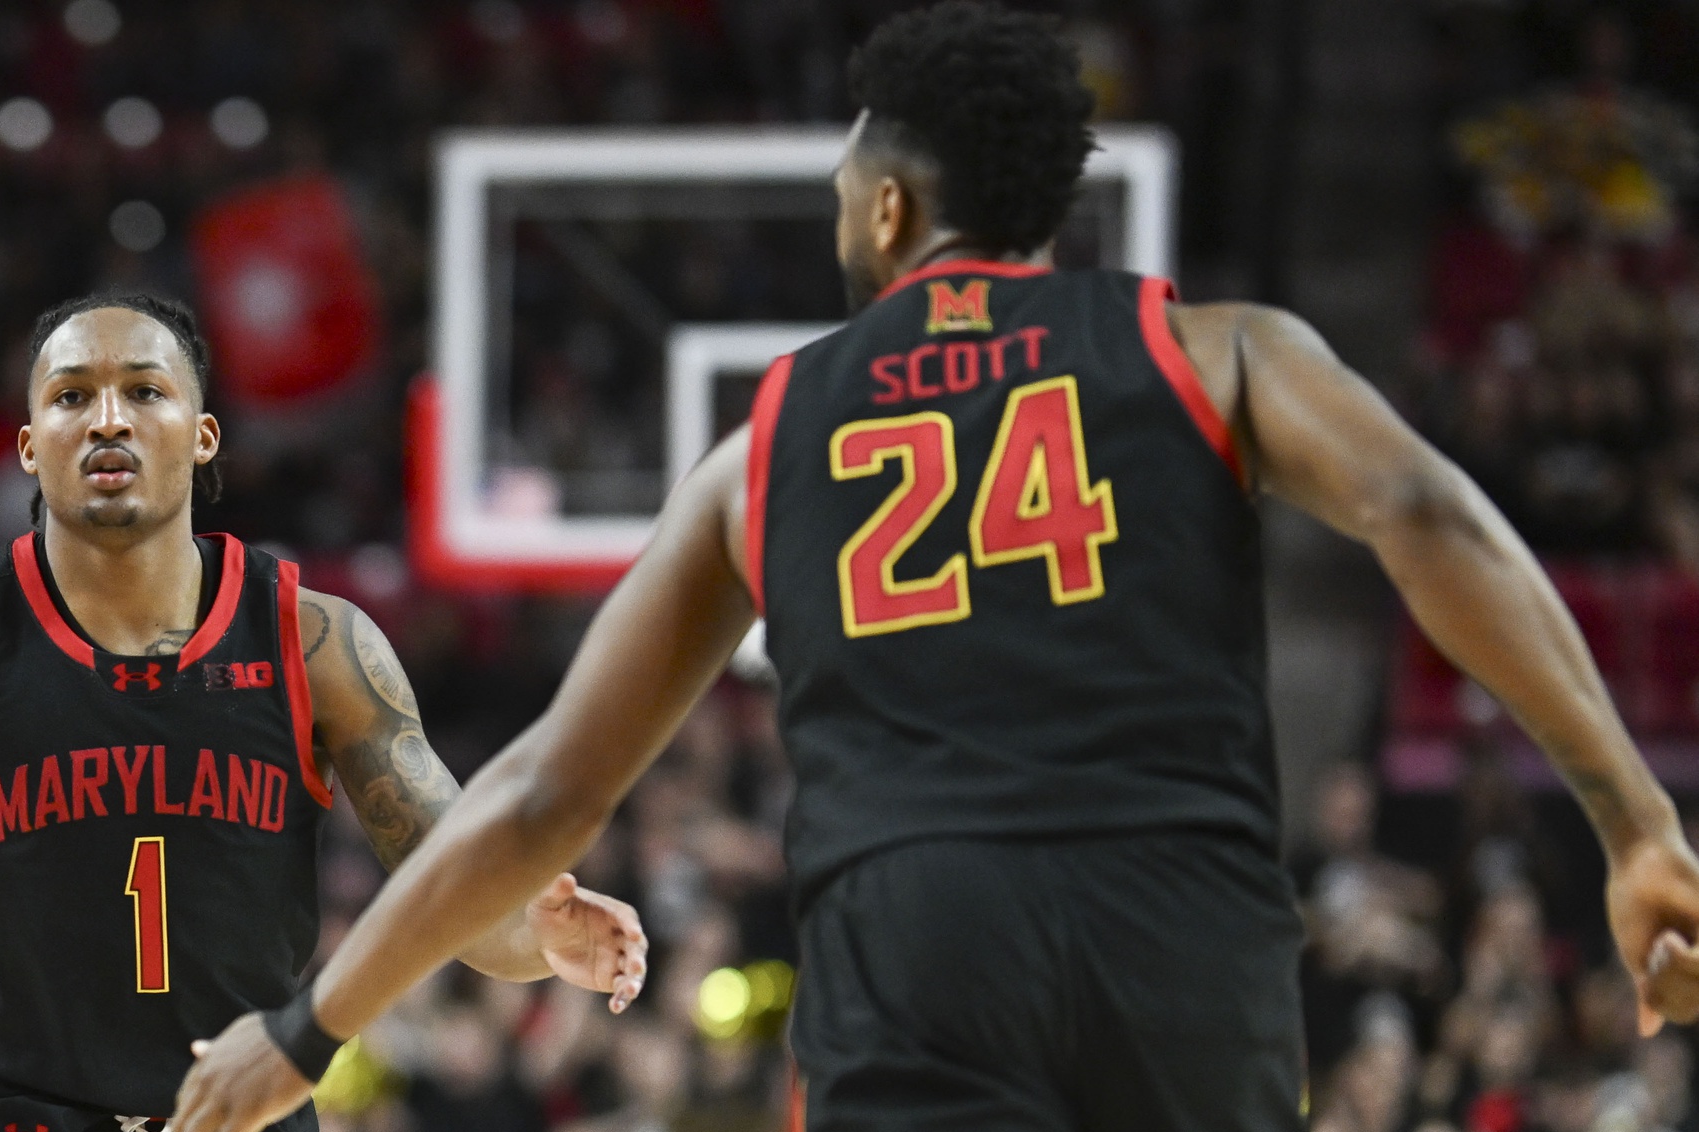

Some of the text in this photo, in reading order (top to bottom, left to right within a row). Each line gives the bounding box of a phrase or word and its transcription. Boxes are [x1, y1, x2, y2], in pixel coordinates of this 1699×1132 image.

[870, 325, 1050, 403] SCOTT
[829, 374, 1119, 638] 24
[124, 836, 170, 993] 1
